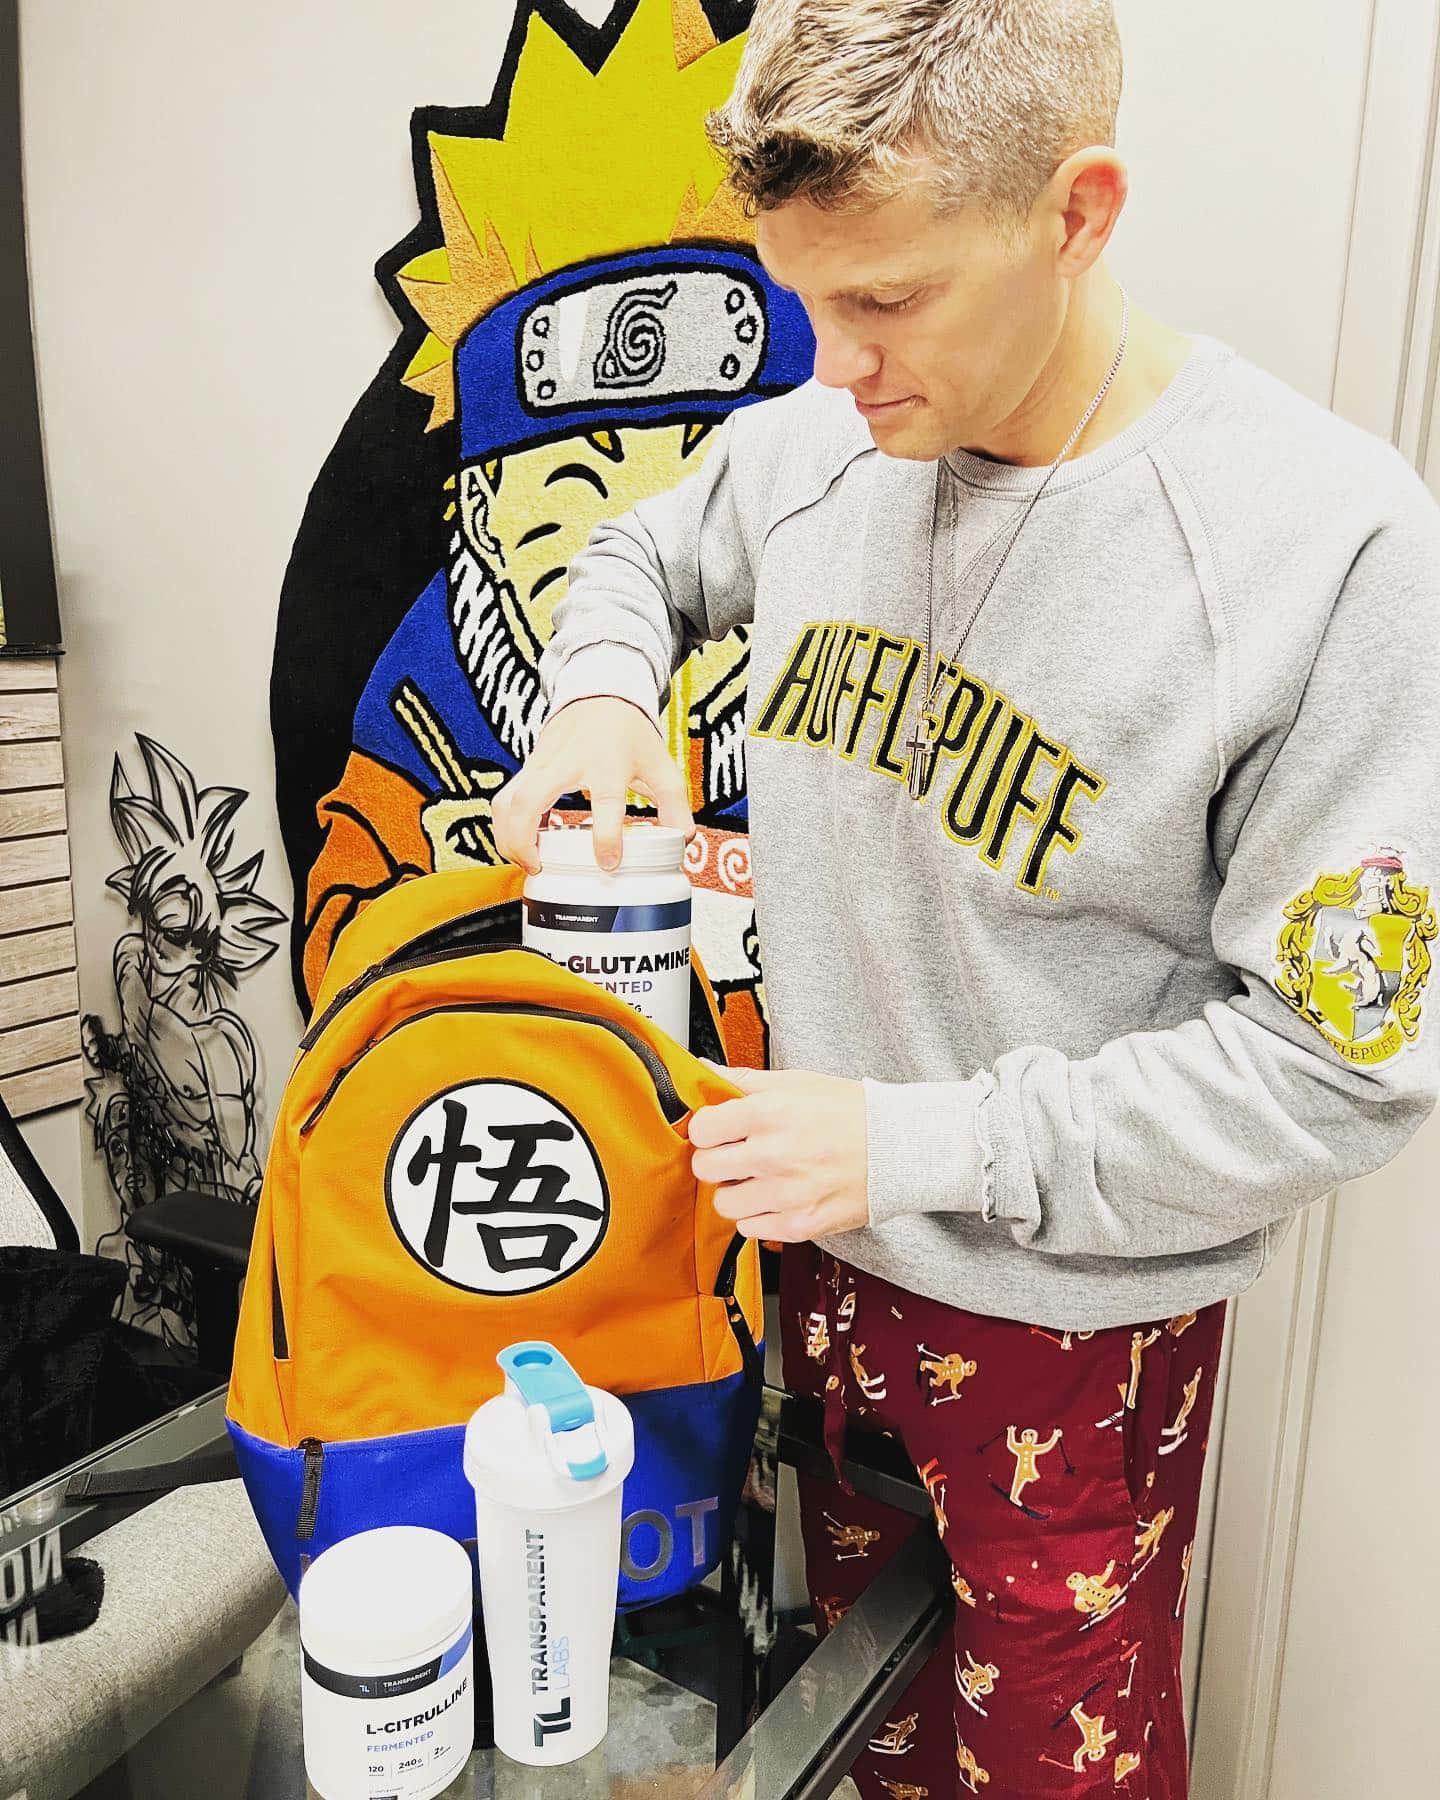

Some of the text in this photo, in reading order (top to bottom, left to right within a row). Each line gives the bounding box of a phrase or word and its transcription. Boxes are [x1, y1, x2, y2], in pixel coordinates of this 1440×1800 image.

[554, 914, 599, 923] TRANSPARENT
[547, 946, 690, 975] -GLUTAMINE
[406, 1098, 605, 1274] 悟
[525, 1528, 549, 1696] TRANSPARENT
[552, 1635, 571, 1691] LABS
[383, 1668, 432, 1688] TRANSPARENT
[366, 1677, 467, 1735] L-CITRULLINE
[367, 1730, 434, 1753] FERMENTED
[368, 1765, 384, 1773] 120
